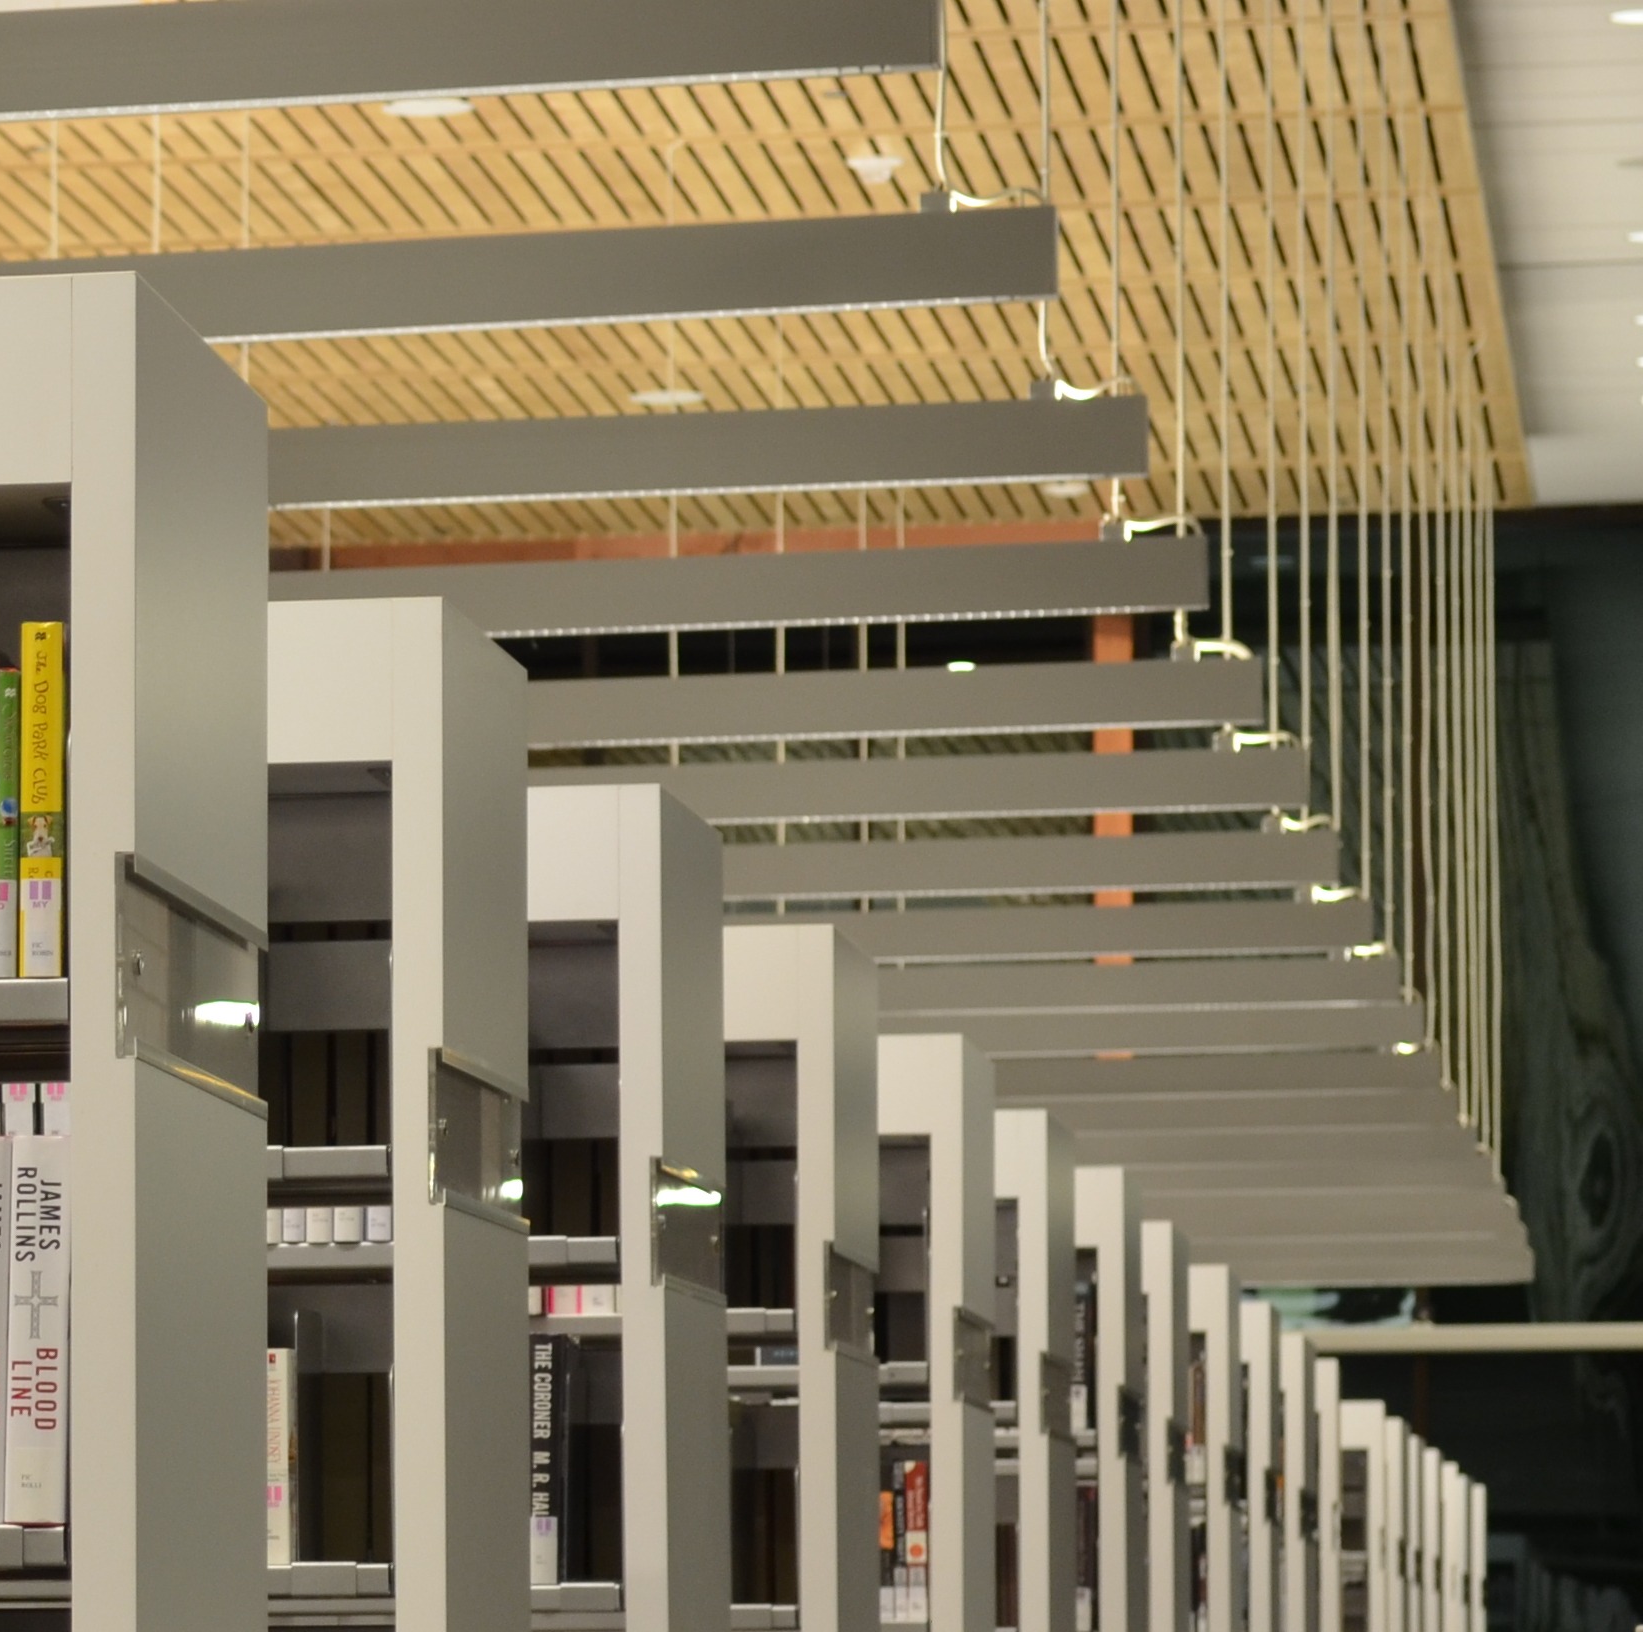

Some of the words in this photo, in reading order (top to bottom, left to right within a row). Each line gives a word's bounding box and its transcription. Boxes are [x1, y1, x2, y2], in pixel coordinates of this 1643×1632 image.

[33, 682, 49, 715] DOG
[14, 1166, 39, 1263] ROLLINS
[39, 1179, 61, 1251] JAMES
[534, 1343, 553, 1370] THE
[11, 1361, 33, 1418] LINE
[34, 1347, 59, 1431] BLOOD
[533, 1372, 553, 1439] CORONER
[532, 1473, 550, 1488] R.
[533, 1451, 551, 1469] M.
